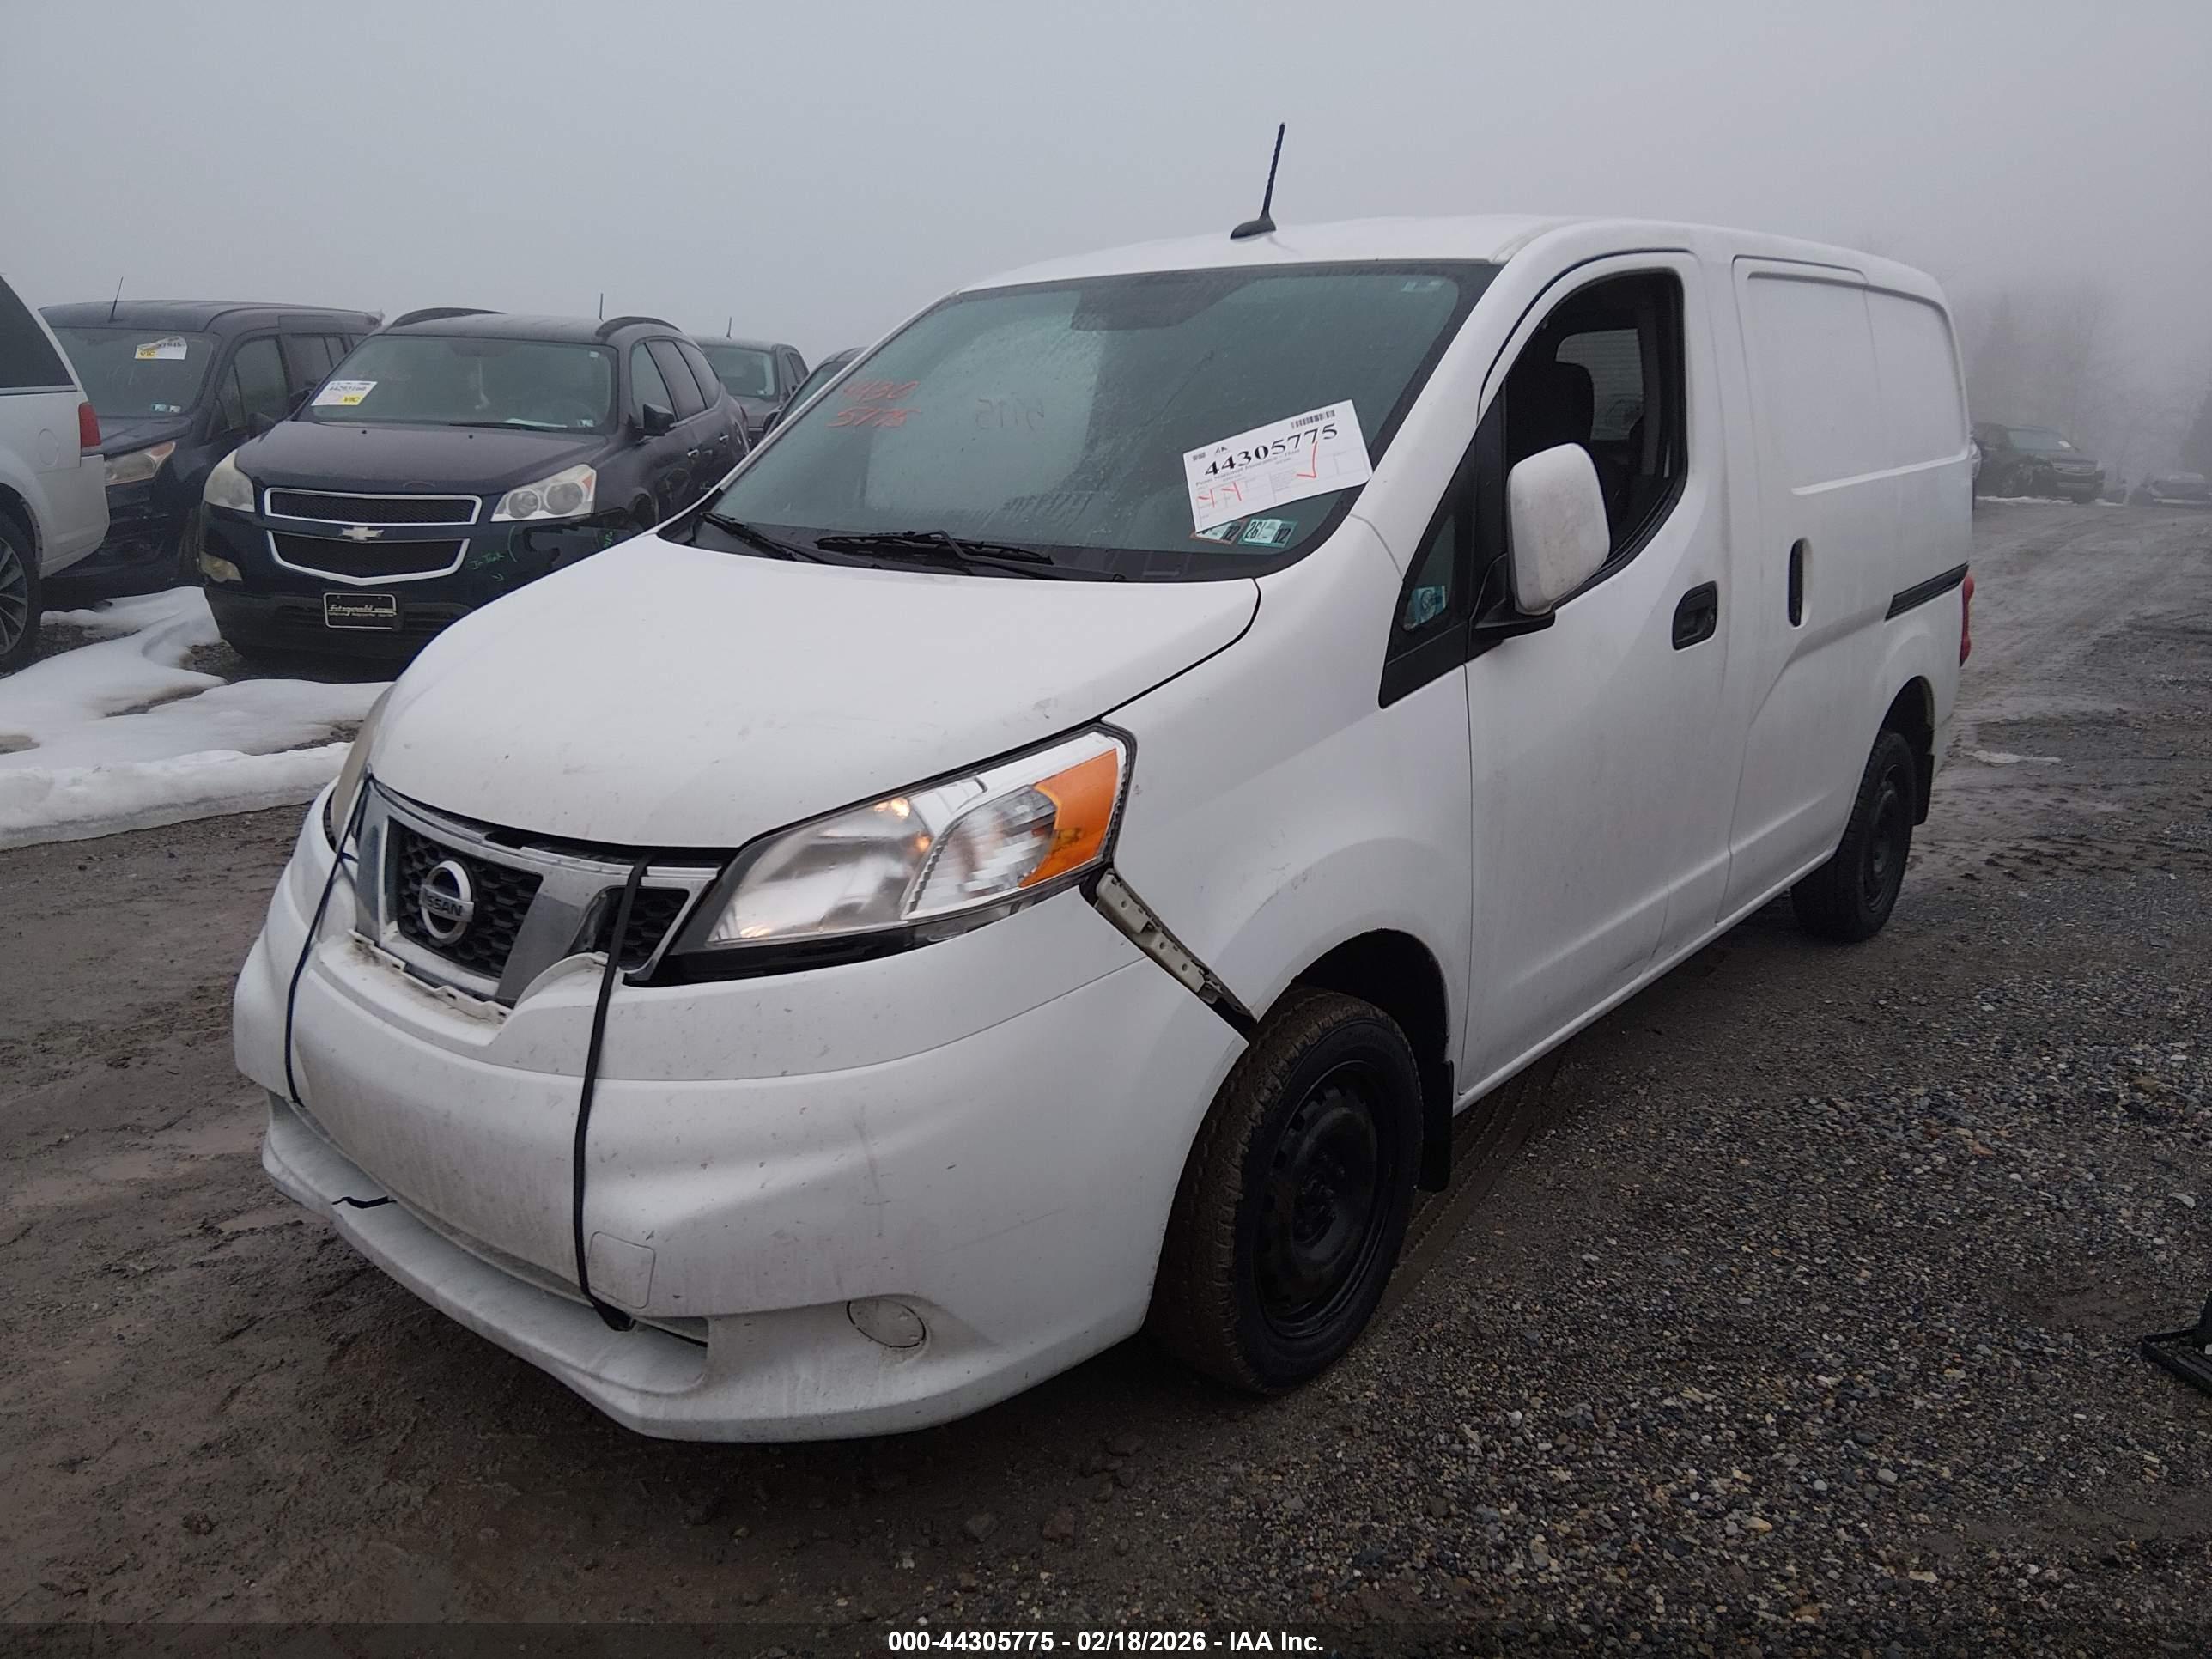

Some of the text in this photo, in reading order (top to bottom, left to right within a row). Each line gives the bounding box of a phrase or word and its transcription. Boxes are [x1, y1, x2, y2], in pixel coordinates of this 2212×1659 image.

[1204, 422, 1339, 476] 44305775
[1244, 520, 1263, 540] 26
[422, 894, 463, 916] SSAN
